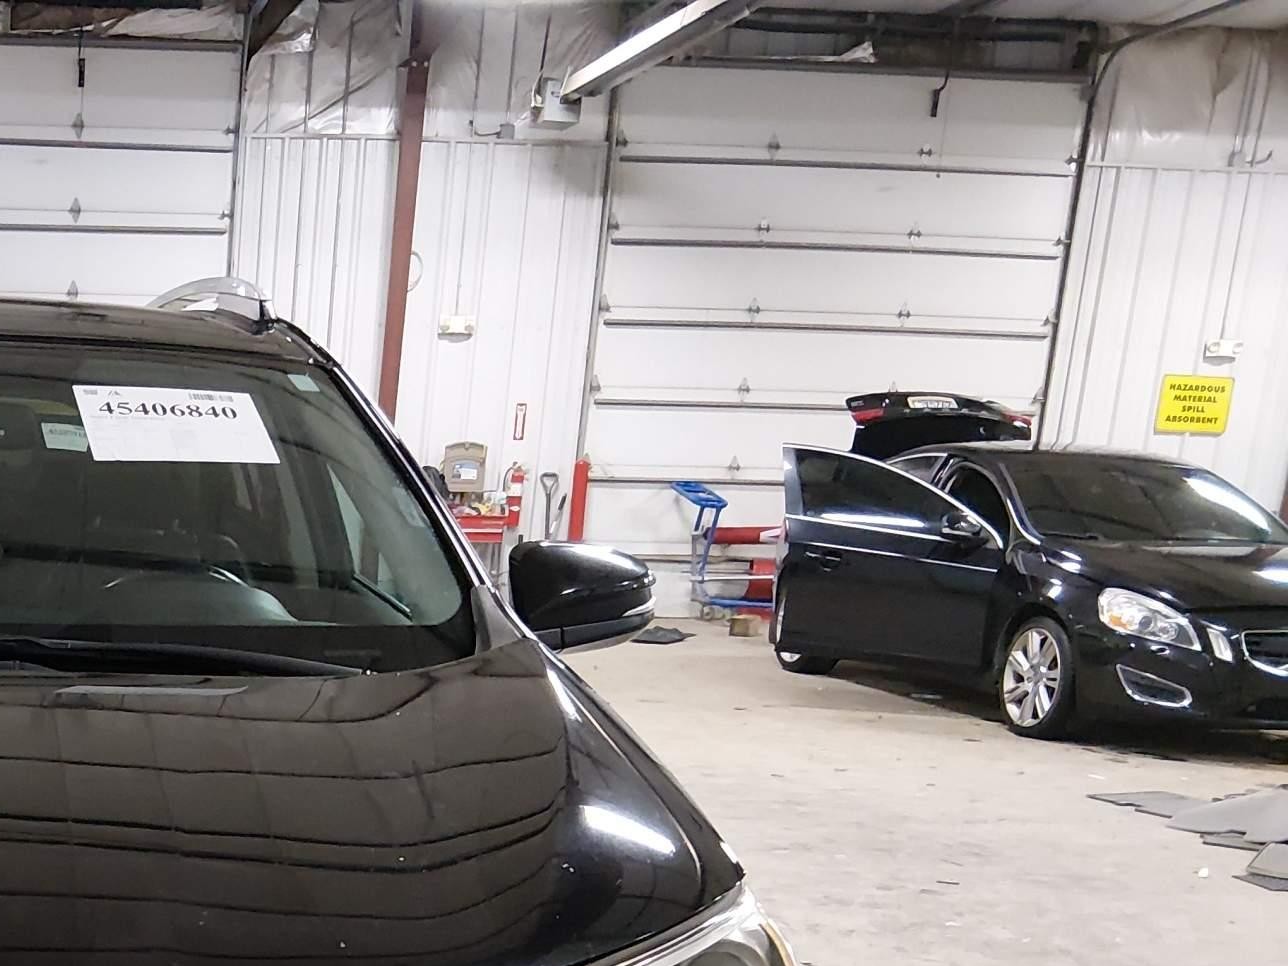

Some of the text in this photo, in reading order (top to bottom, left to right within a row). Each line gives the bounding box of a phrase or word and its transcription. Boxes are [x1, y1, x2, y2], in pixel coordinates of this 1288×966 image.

[1169, 384, 1226, 393] HAZARDOUS
[1173, 395, 1217, 403] MATERIAL
[99, 402, 237, 419] 45406840
[1181, 405, 1205, 413] SPILL
[1165, 415, 1218, 424] ABSORBENT
